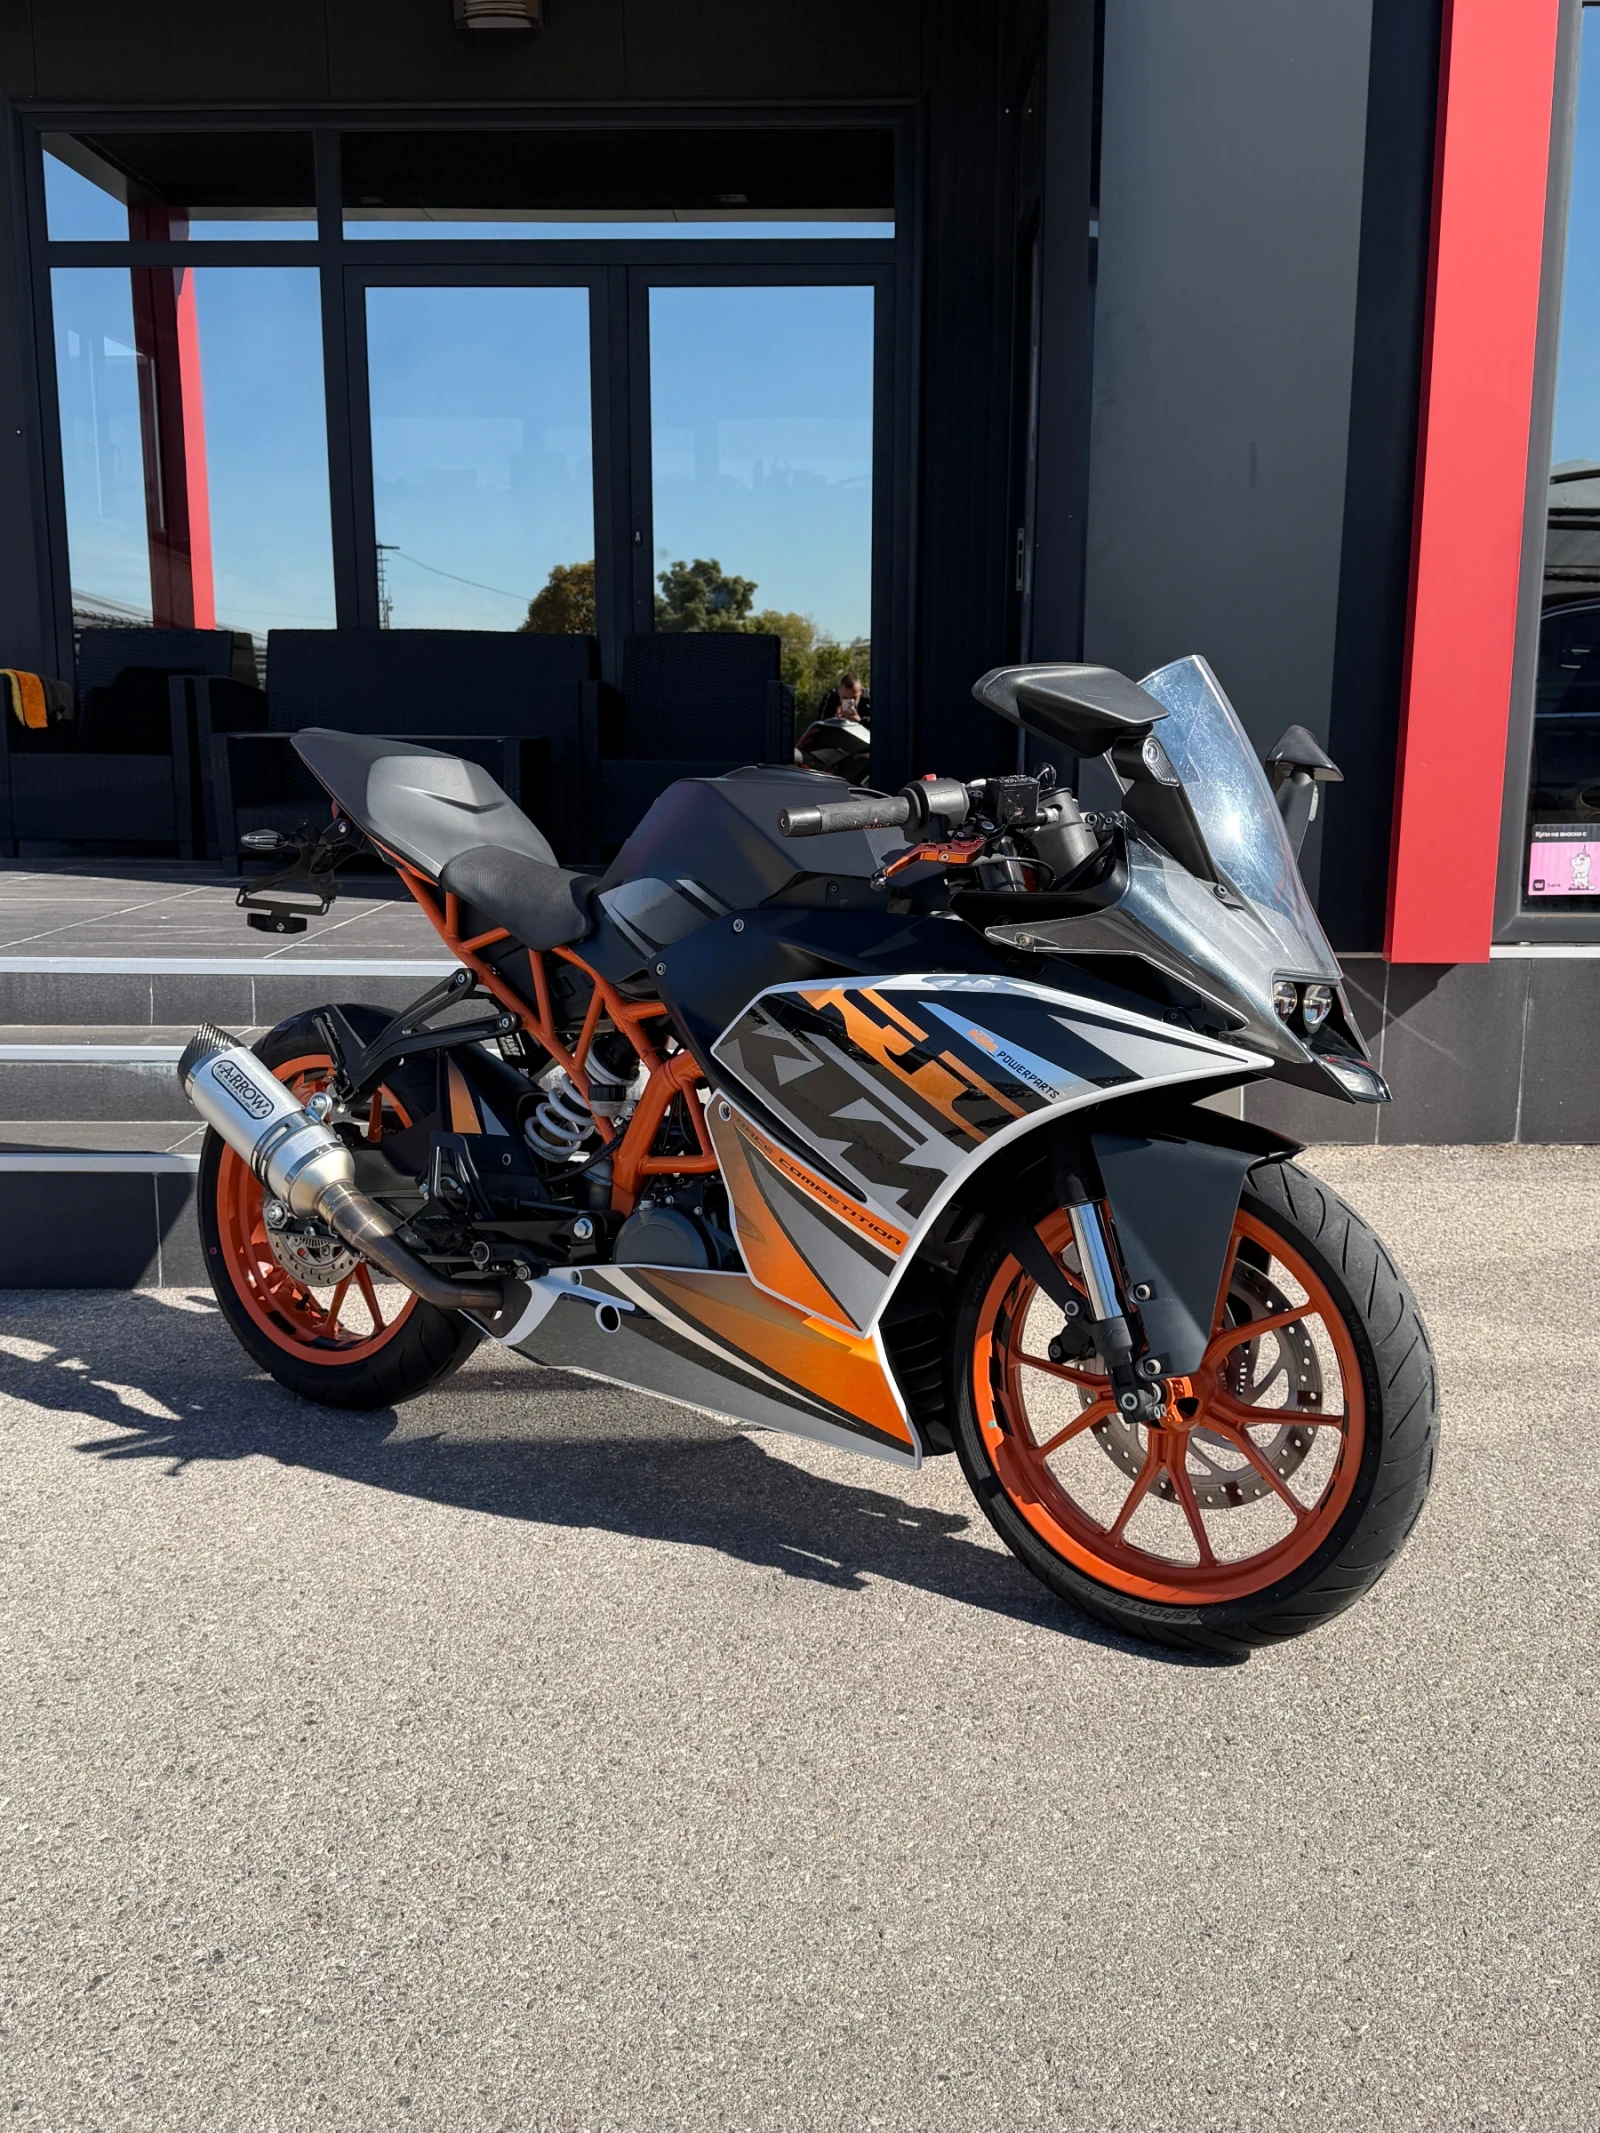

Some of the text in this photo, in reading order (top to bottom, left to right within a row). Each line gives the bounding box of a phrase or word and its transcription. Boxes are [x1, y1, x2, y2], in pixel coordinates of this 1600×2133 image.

[220, 1066, 270, 1110] ARROW
[719, 1003, 949, 1220] KTM
[996, 1050, 1061, 1099] POWERPARTS
[736, 1118, 902, 1246] RACE COMPETITION
[1348, 1313, 1379, 1413] METZELER
[1101, 1594, 1191, 1621] SPORTEC
